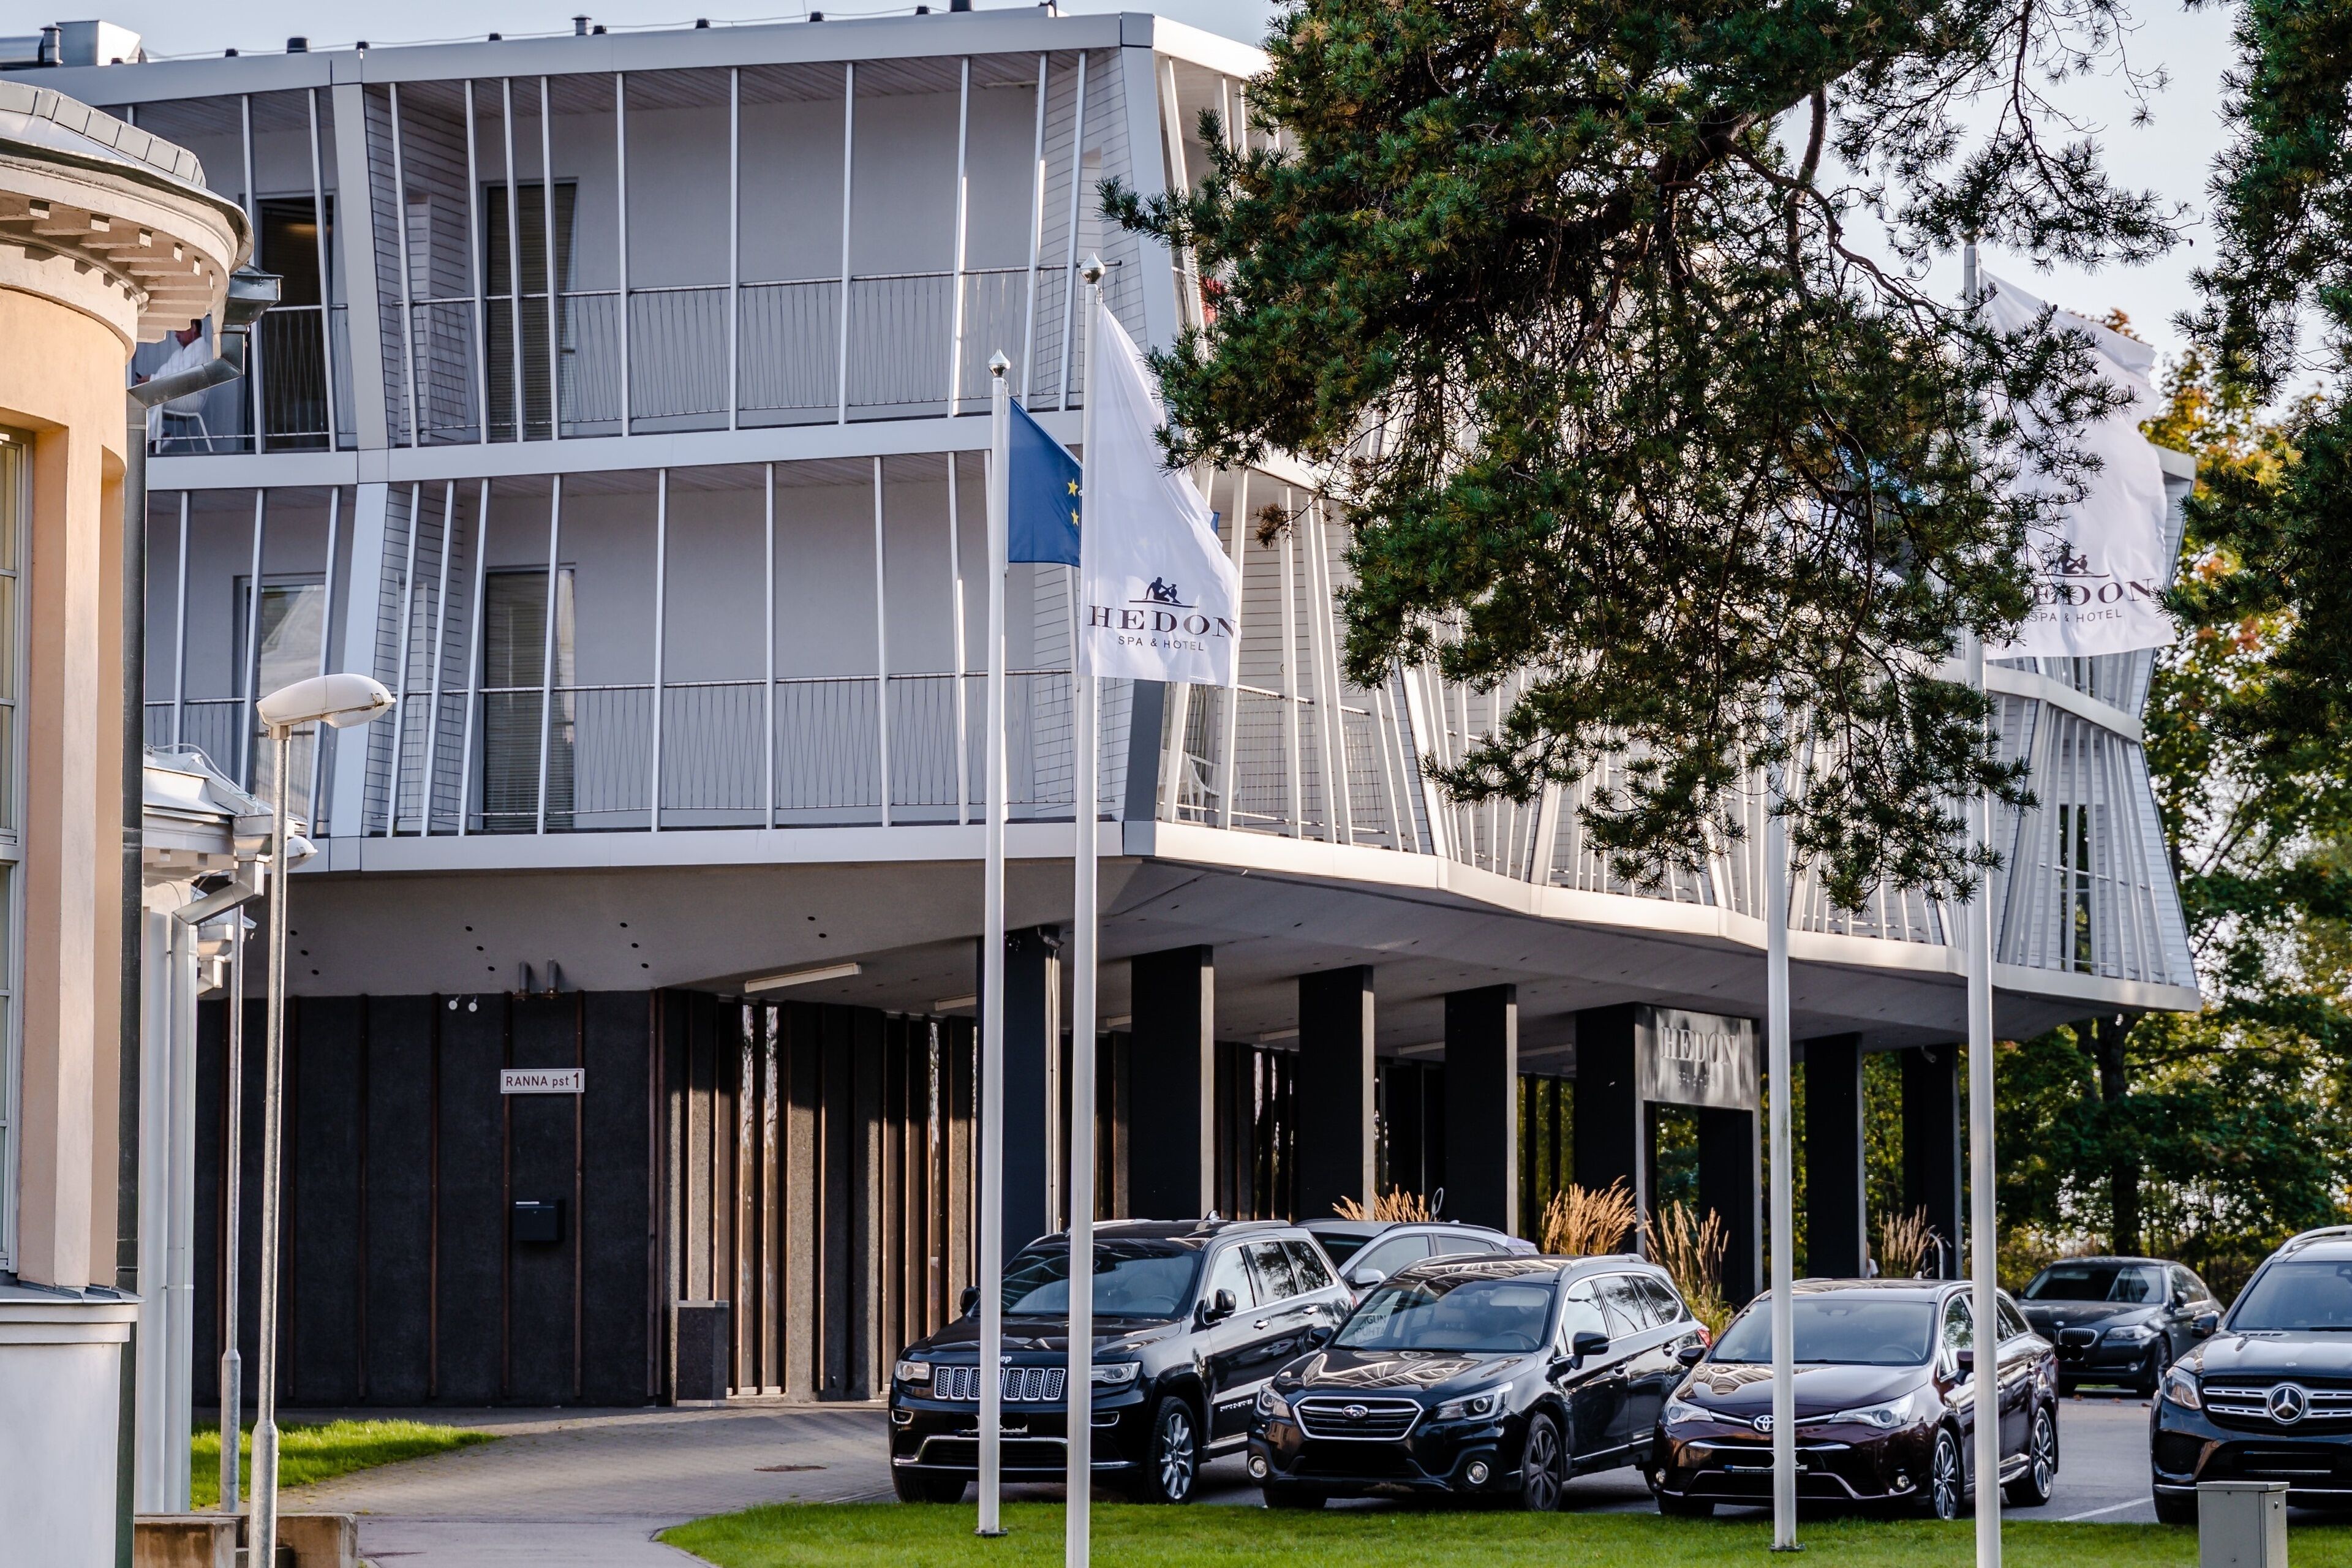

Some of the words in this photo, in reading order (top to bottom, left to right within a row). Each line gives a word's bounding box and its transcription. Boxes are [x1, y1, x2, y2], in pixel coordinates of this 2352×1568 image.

[2032, 578, 2155, 606] EDON
[1087, 605, 1237, 639] HEDON
[2030, 612, 2057, 622] SPA
[2064, 612, 2069, 622] &
[2076, 609, 2122, 623] HOTEL
[1118, 636, 1143, 646] SPA
[1150, 638, 1158, 647] &
[1164, 640, 1204, 651] HOTEL
[1661, 1027, 1737, 1065] HEDON
[506, 1076, 548, 1087] RANNA
[552, 1076, 569, 1088] pst
[573, 1072, 579, 1089] 1
